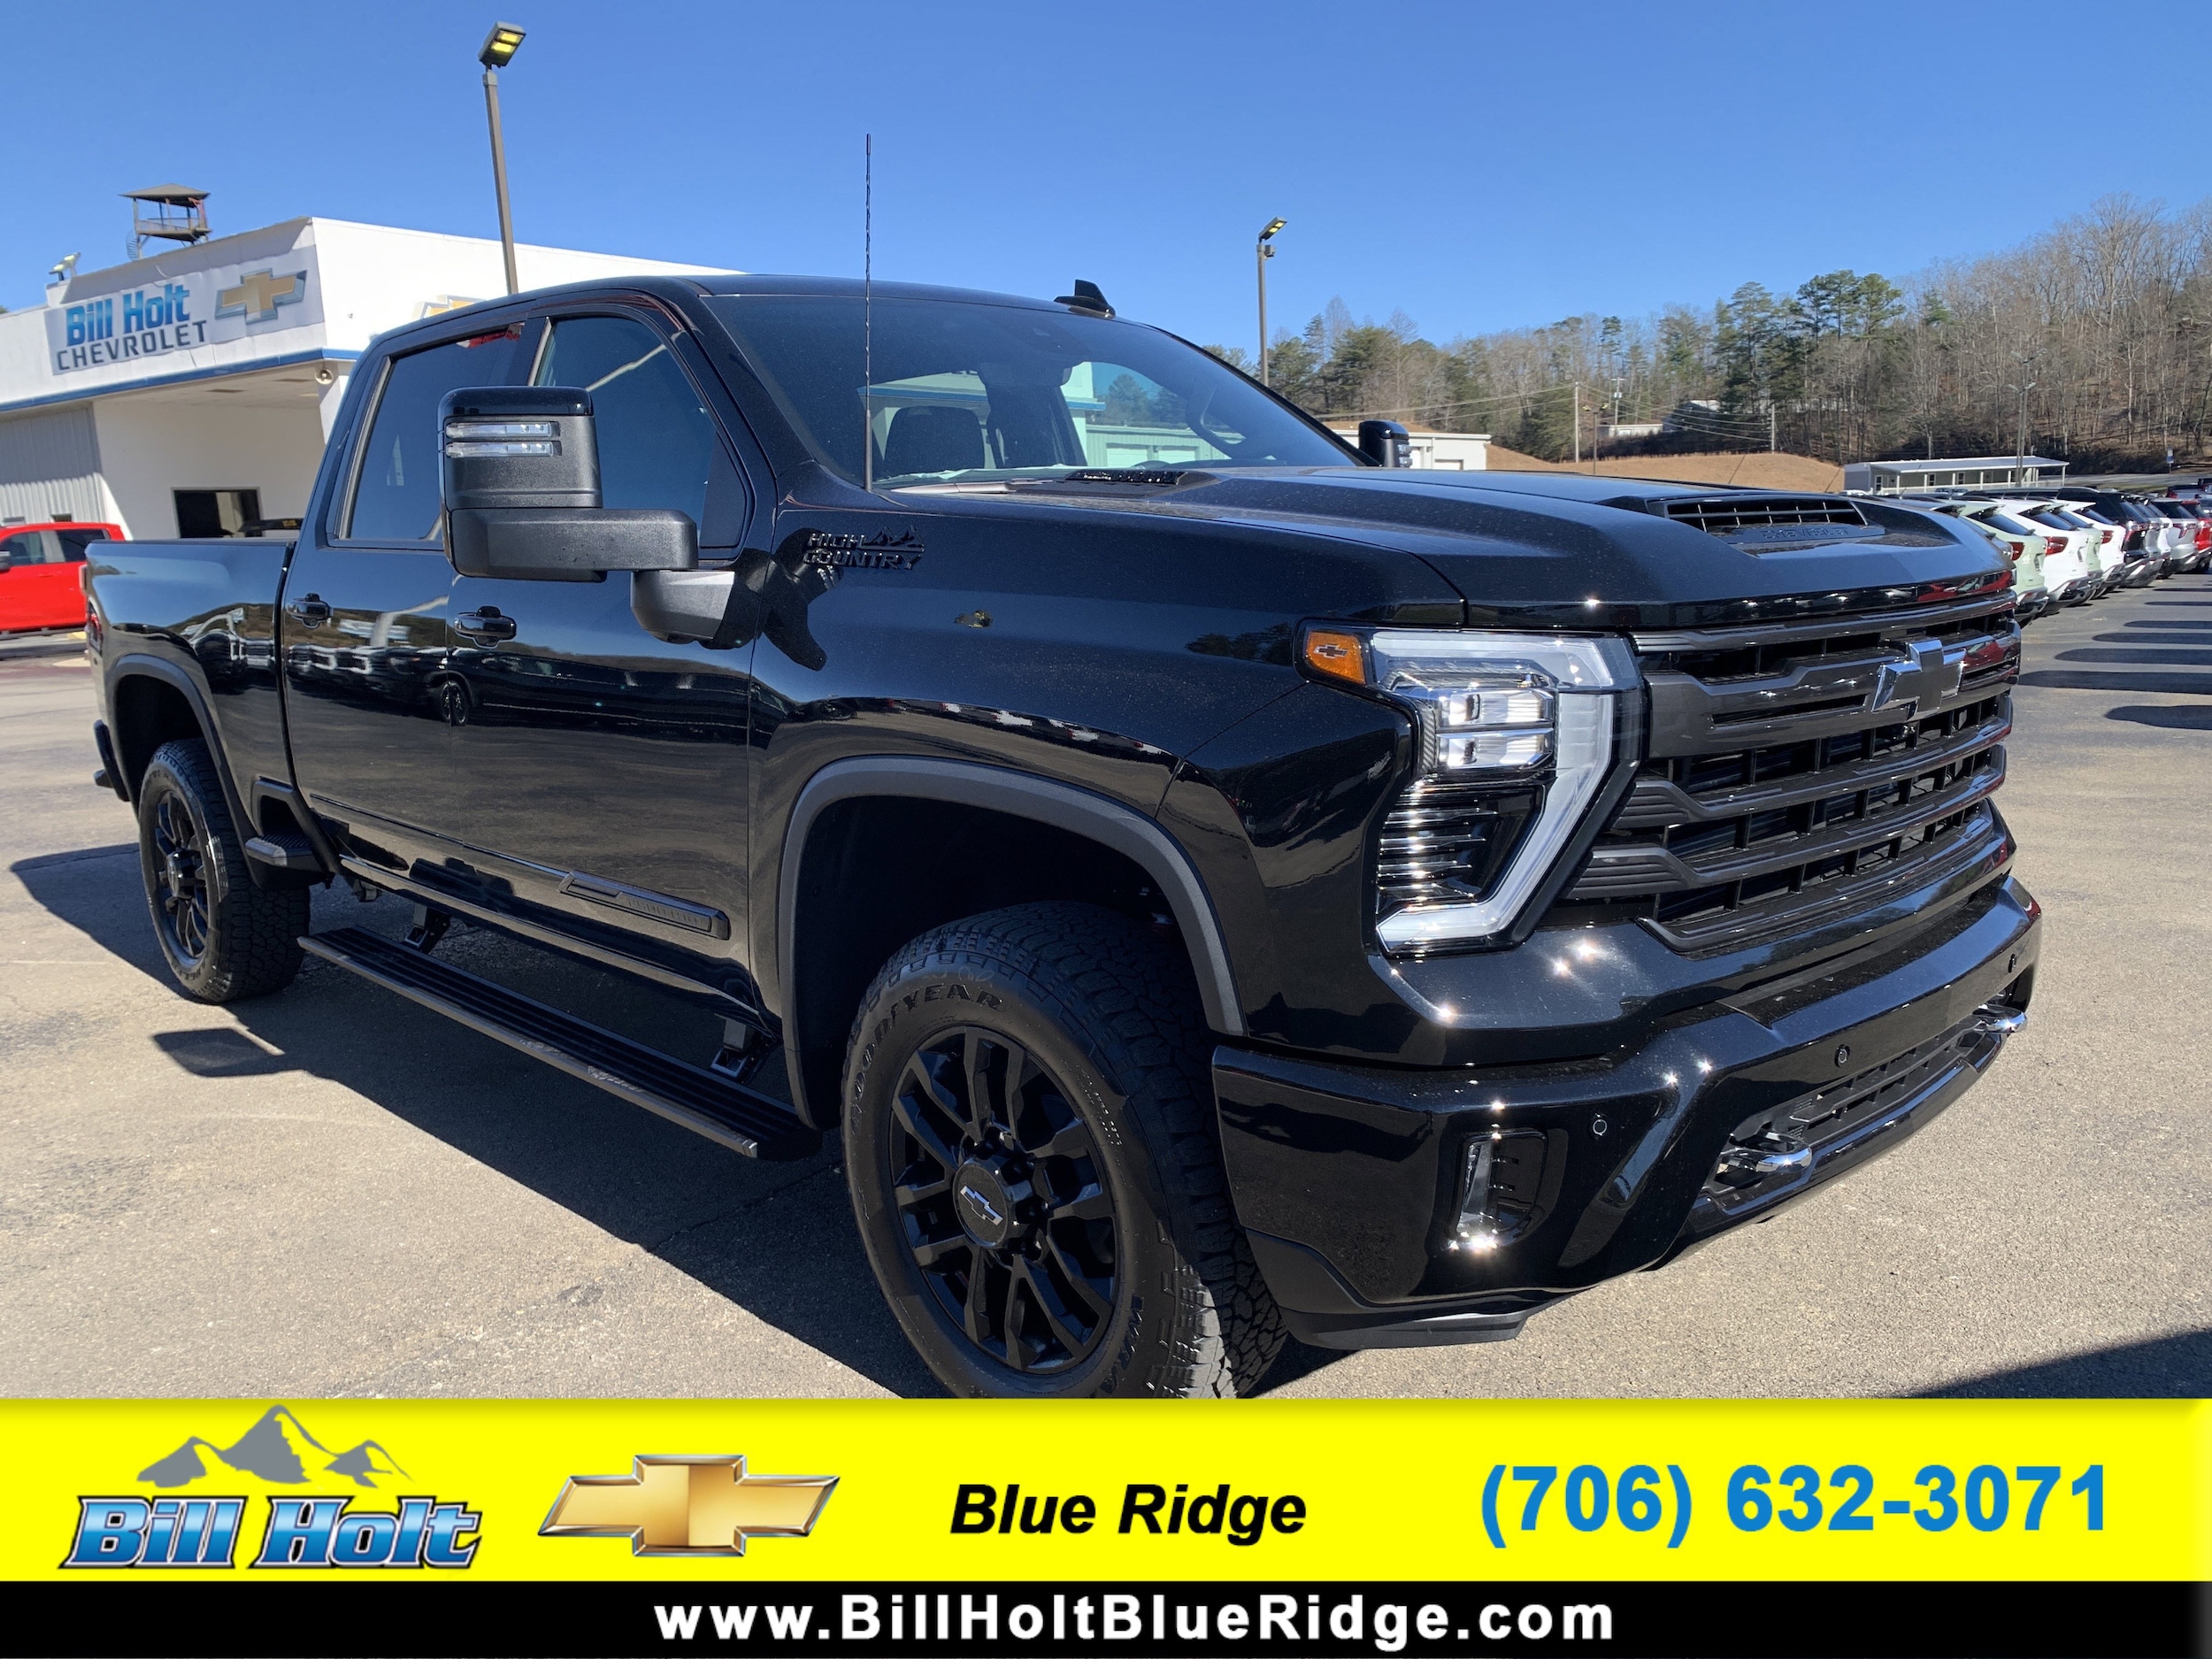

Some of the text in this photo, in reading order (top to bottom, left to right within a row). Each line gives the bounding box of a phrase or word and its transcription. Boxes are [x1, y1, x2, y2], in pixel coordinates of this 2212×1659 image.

[65, 282, 191, 346] Bill Holt
[57, 319, 207, 371] CHEVROLET
[807, 533, 866, 548] HIGH
[1760, 526, 1849, 539] CHEVROLET
[803, 549, 922, 570] COUNTRY
